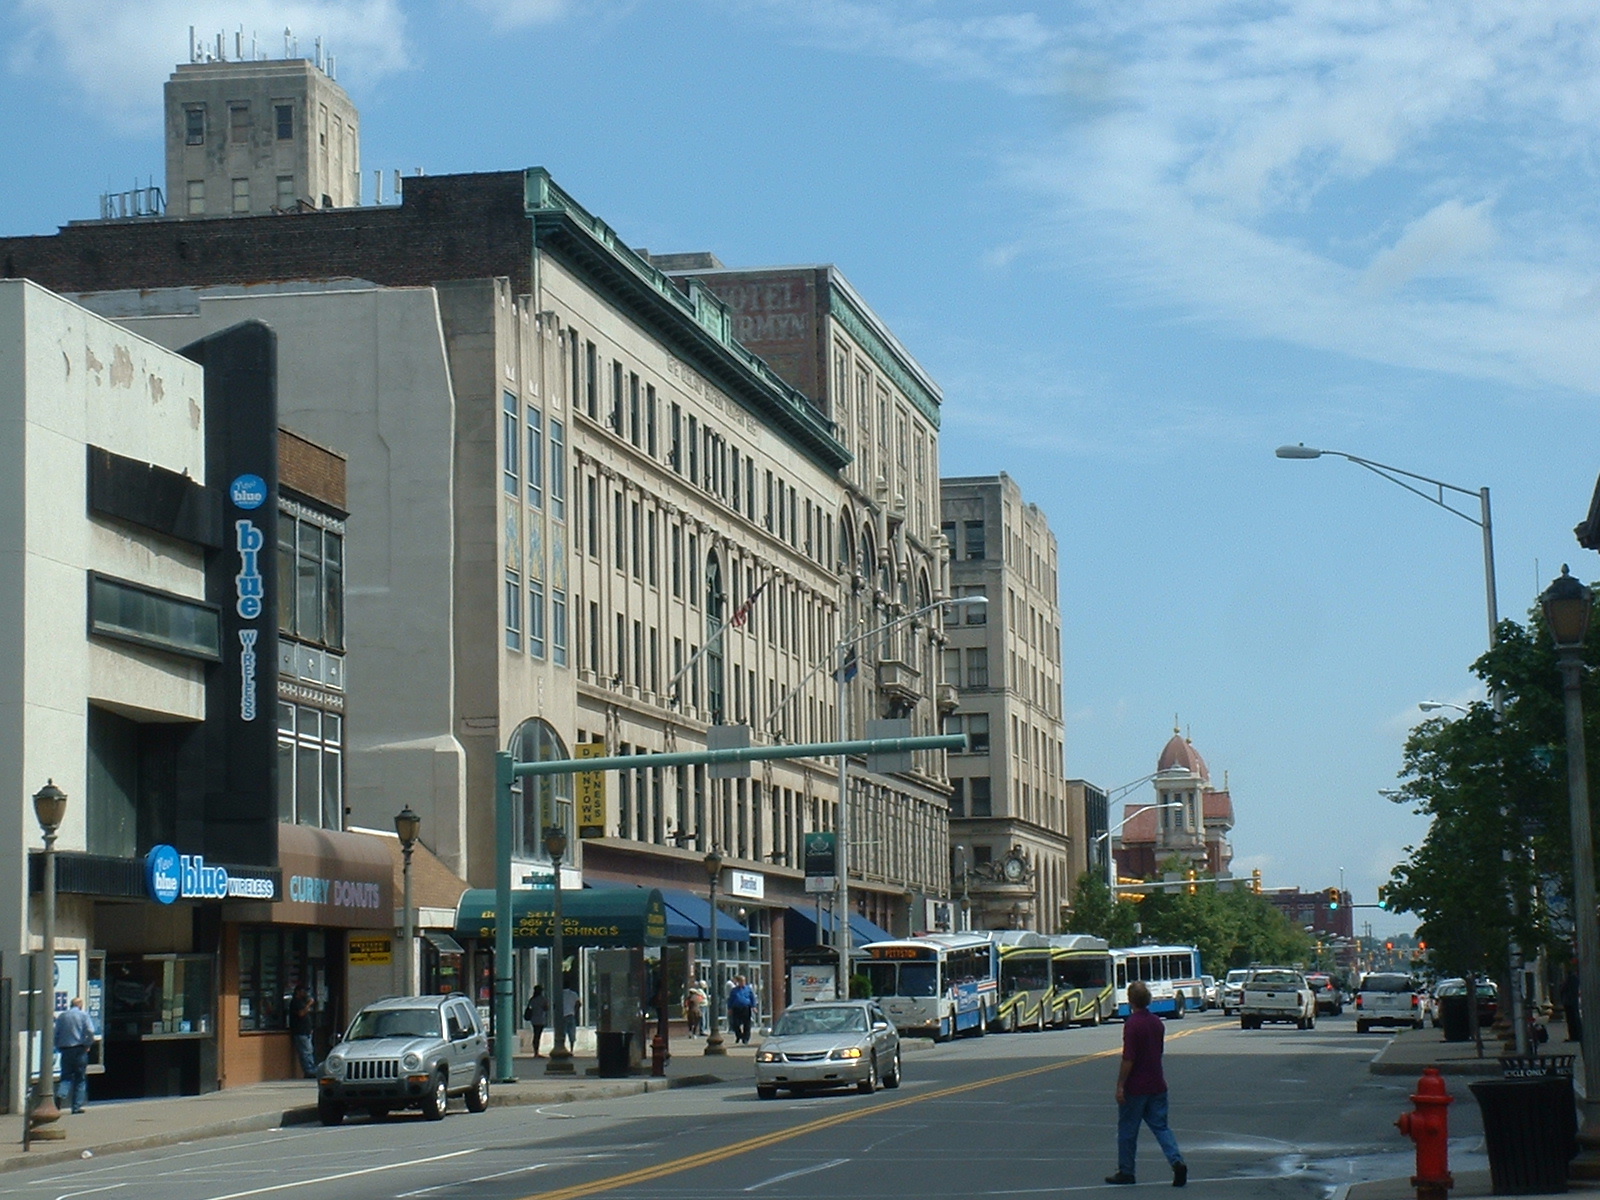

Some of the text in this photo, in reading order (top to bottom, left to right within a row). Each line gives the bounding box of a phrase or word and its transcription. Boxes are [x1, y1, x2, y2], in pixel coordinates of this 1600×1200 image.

[233, 489, 263, 501] blue
[236, 519, 264, 619] blue
[238, 629, 258, 721] WIRELESS
[582, 748, 593, 823] DNTOWN
[593, 752, 602, 818] FTNESS
[155, 872, 178, 890] blue
[180, 854, 228, 899] blue
[227, 877, 275, 899] WIRELESS
[290, 875, 380, 909] CURRY DONUTS
[544, 925, 619, 937] CSHING$
[1526, 1069, 1547, 1077] ONLY
